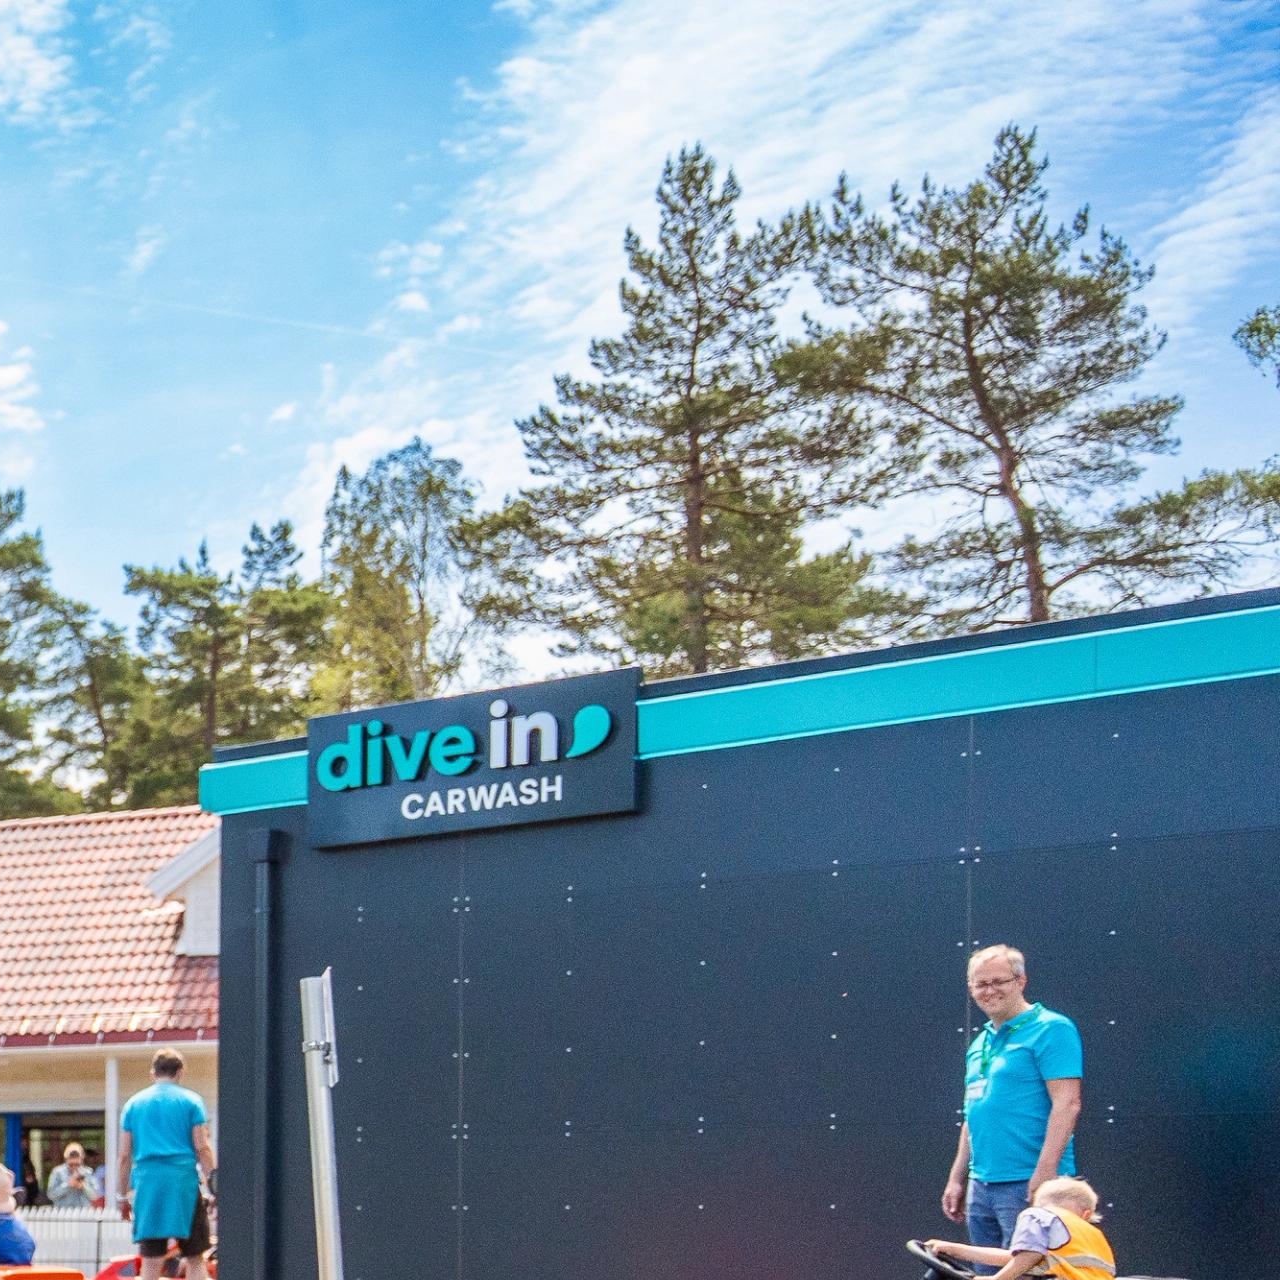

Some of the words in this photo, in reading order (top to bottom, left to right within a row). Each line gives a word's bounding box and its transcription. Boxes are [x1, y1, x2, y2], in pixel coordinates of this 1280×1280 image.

[316, 719, 476, 792] dive
[489, 699, 559, 769] in
[401, 775, 563, 820] CARWASH
